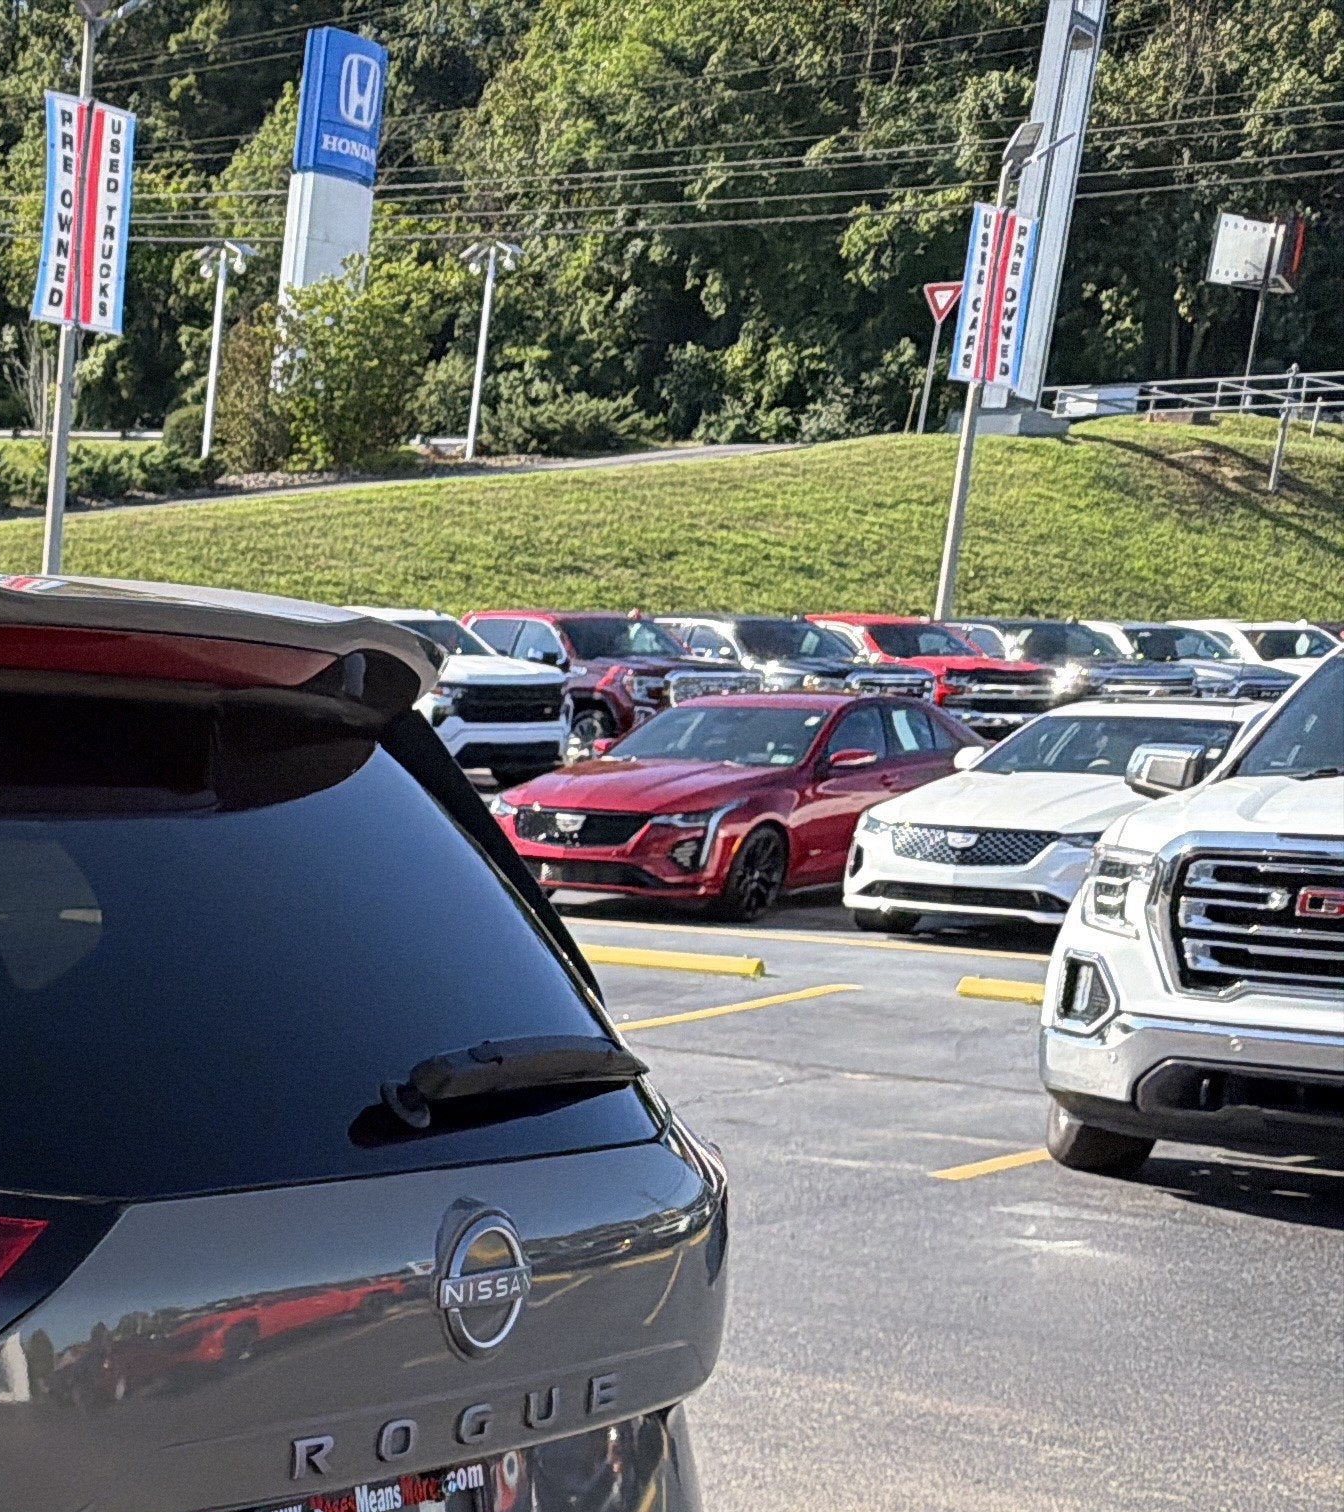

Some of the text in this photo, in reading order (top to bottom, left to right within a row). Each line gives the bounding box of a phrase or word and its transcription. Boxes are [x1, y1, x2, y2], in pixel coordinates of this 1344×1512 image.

[48, 109, 74, 308] PRE OWNED
[98, 118, 122, 317] USED TRUCKS
[962, 213, 992, 370] USED CARS
[999, 225, 1028, 376] PRE OWNED
[444, 1272, 531, 1305] NISSAN
[289, 1372, 619, 1480] ROGUE
